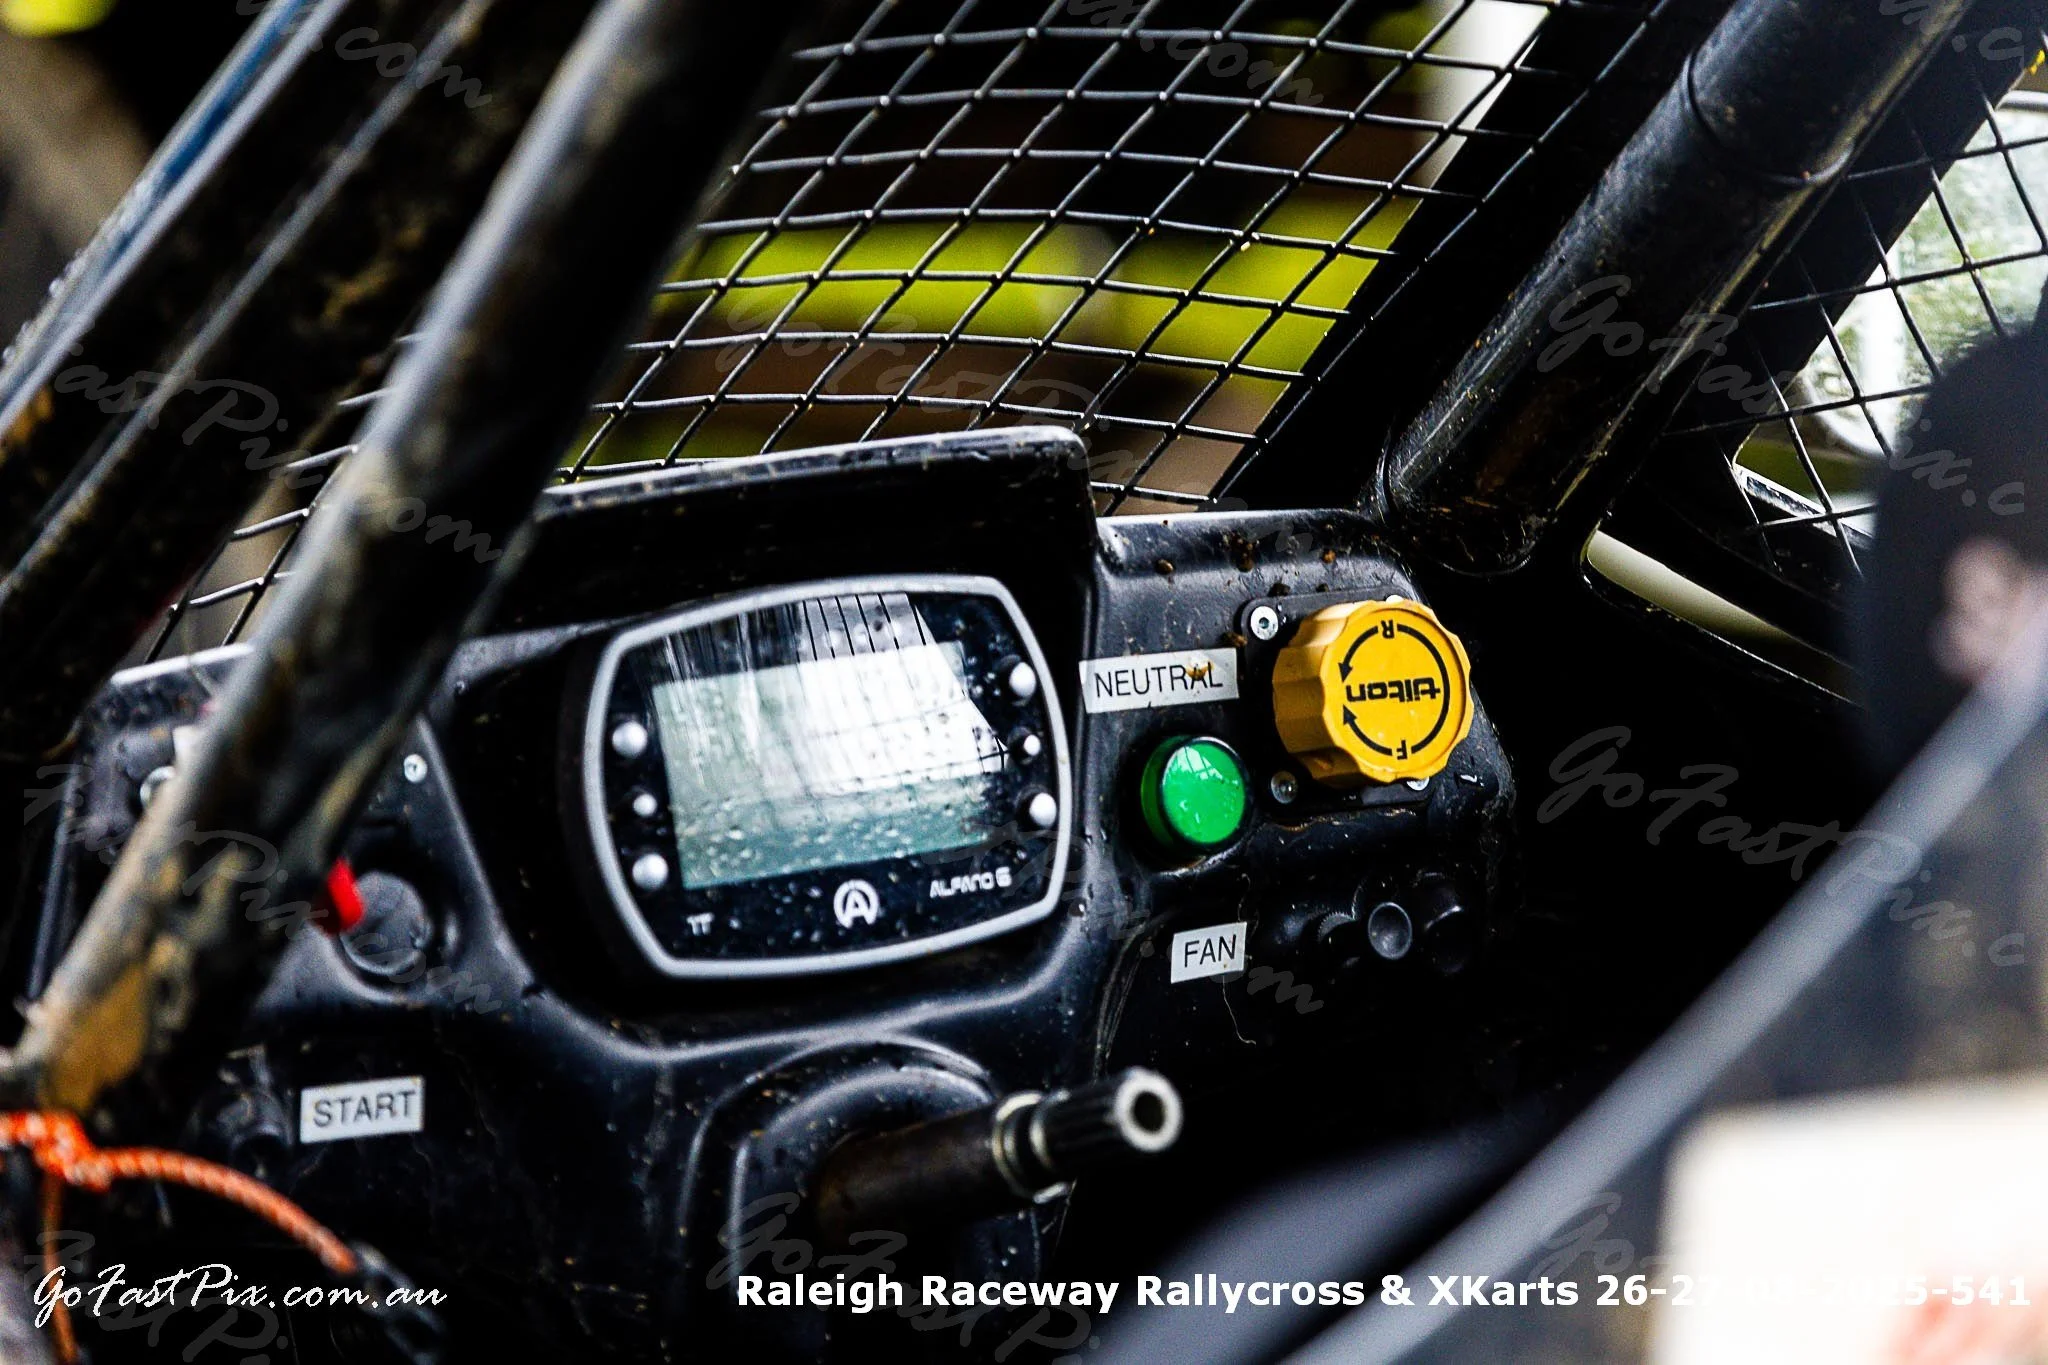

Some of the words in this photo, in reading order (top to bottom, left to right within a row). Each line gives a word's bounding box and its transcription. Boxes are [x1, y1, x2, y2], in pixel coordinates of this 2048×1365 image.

[1381, 620, 1394, 639] R
[1094, 661, 1223, 698] NEUTRAL
[1346, 677, 1440, 703] tilton
[1397, 740, 1408, 760] F
[1184, 934, 1237, 968] FAN
[313, 1090, 416, 1128] START
